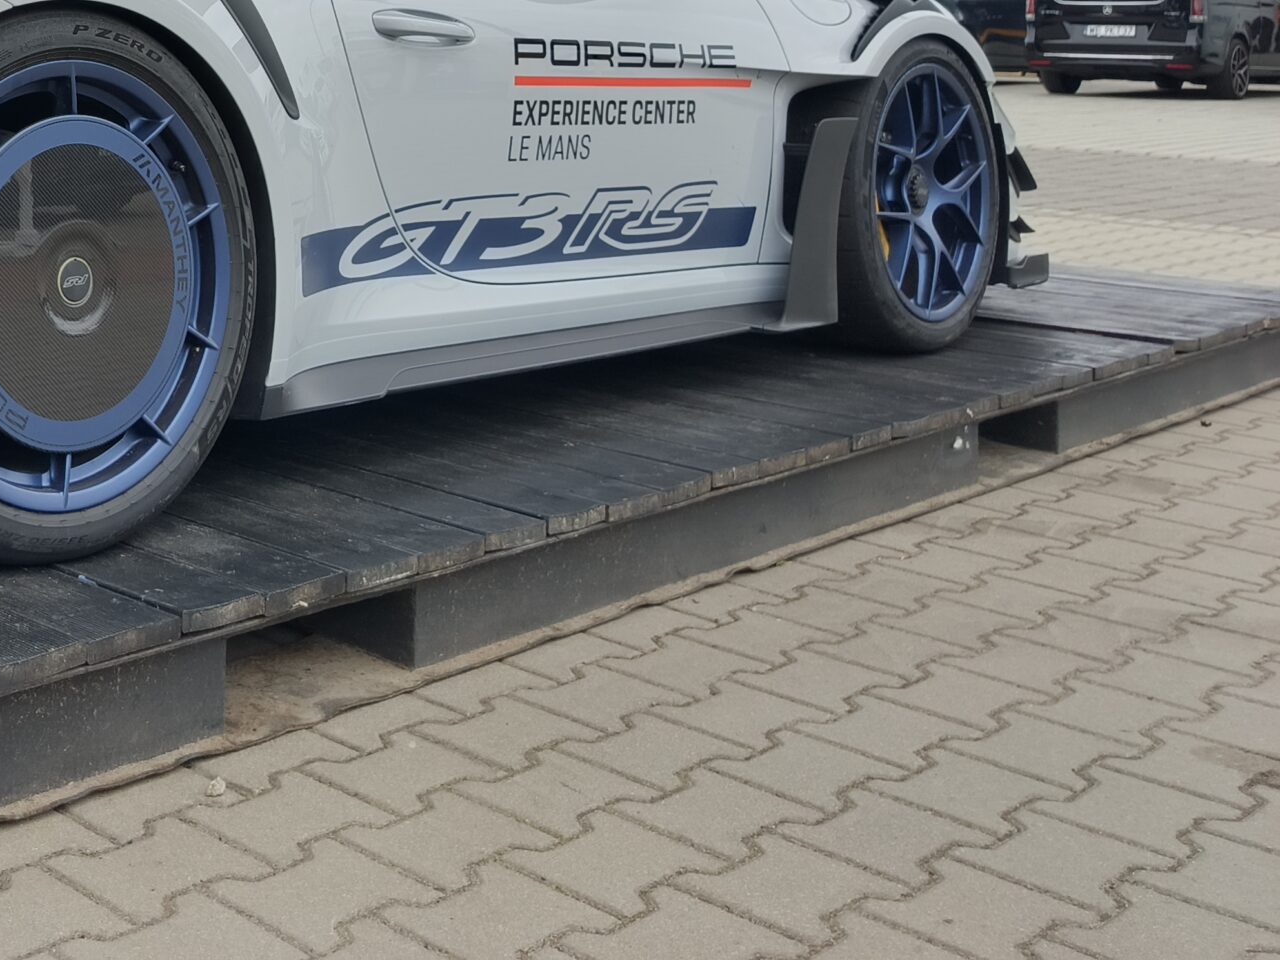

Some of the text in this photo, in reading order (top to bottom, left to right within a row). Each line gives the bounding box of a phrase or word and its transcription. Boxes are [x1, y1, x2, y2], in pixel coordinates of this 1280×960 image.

[72, 24, 163, 63] P ZERO
[514, 37, 738, 68] PORSCHE
[512, 99, 696, 126] EXPERIENCE CENTER
[507, 134, 591, 162] LE MANS
[152, 173, 188, 314] MANTHEY
